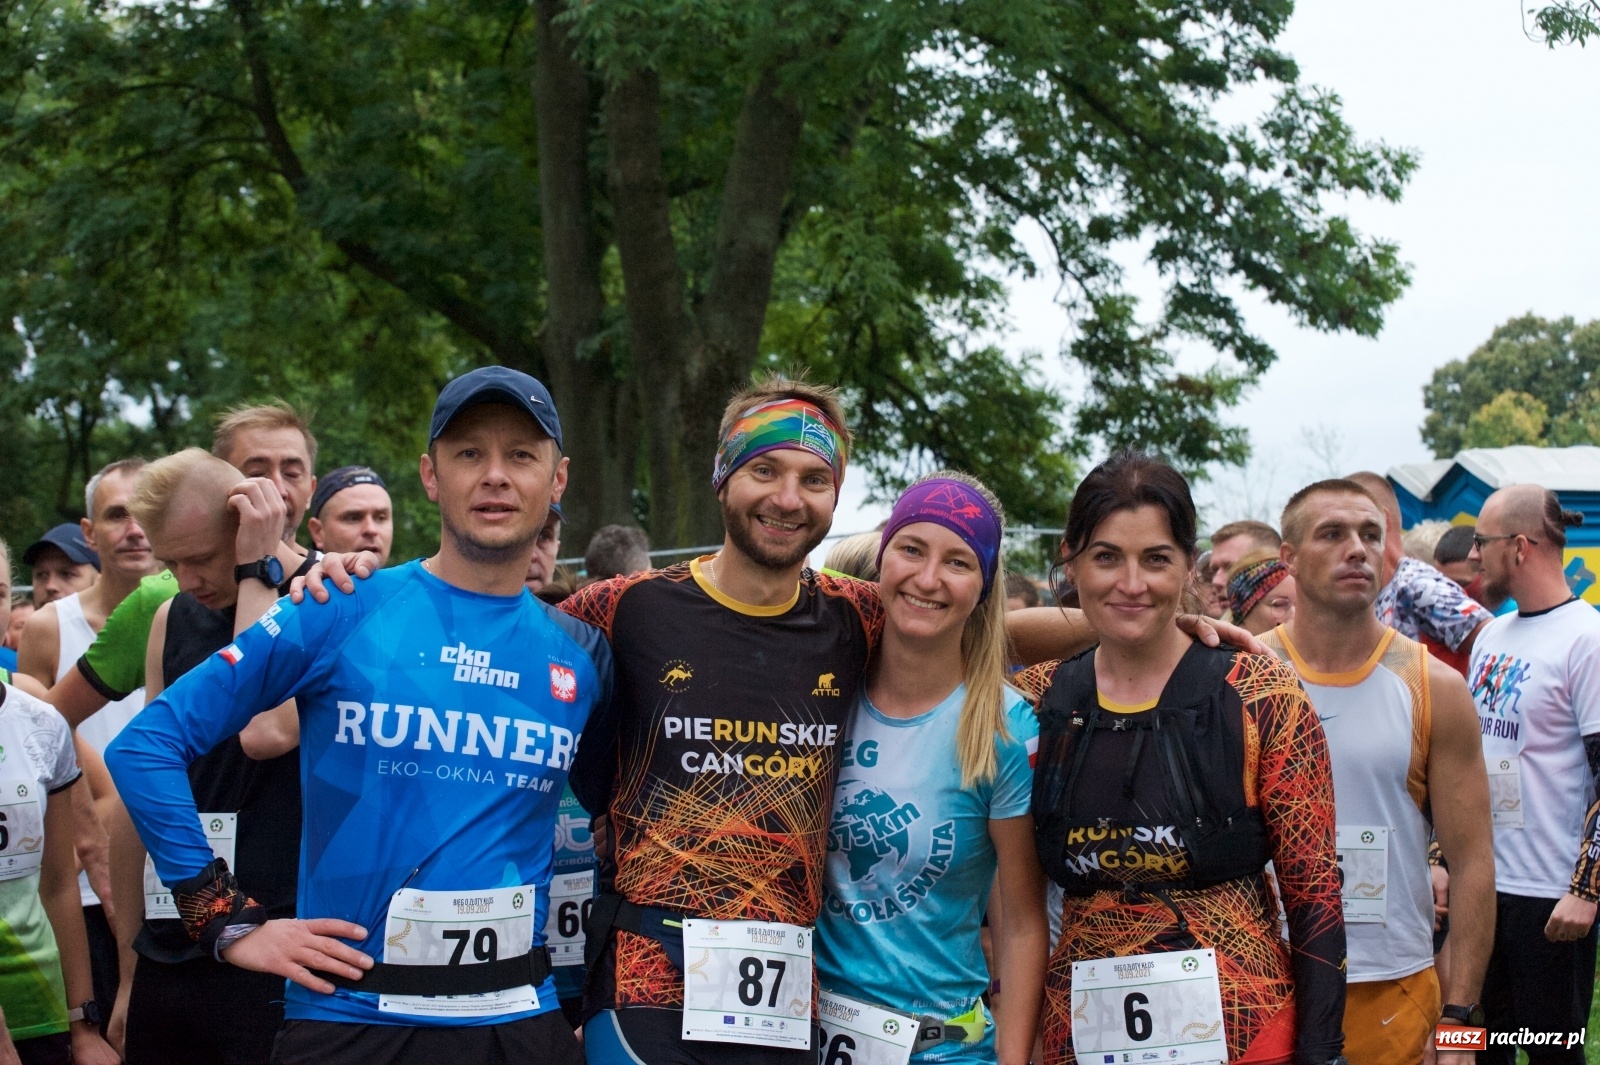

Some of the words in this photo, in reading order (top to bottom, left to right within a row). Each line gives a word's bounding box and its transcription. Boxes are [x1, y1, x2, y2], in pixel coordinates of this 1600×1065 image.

[811, 687, 840, 698] ATTIQ
[664, 717, 838, 746] PIERUNSKIE
[1479, 716, 1493, 736] UR
[1493, 718, 1519, 741] RUN
[680, 750, 823, 780] CANGÓRY
[505, 772, 554, 794] TEAM
[868, 802, 921, 839] km
[896, 820, 954, 909] ŚWIATA
[453, 898, 464, 906] BIEG
[457, 904, 490, 915] 19.09.2021
[747, 927, 758, 936] BIEG
[751, 934, 783, 946] 19.09.2021
[442, 928, 498, 965] 79
[738, 956, 787, 1008] 87
[1117, 967, 1150, 980] 19.09.2021
[820, 1004, 855, 1023] 19.09.2021
[1123, 992, 1153, 1042] 6
